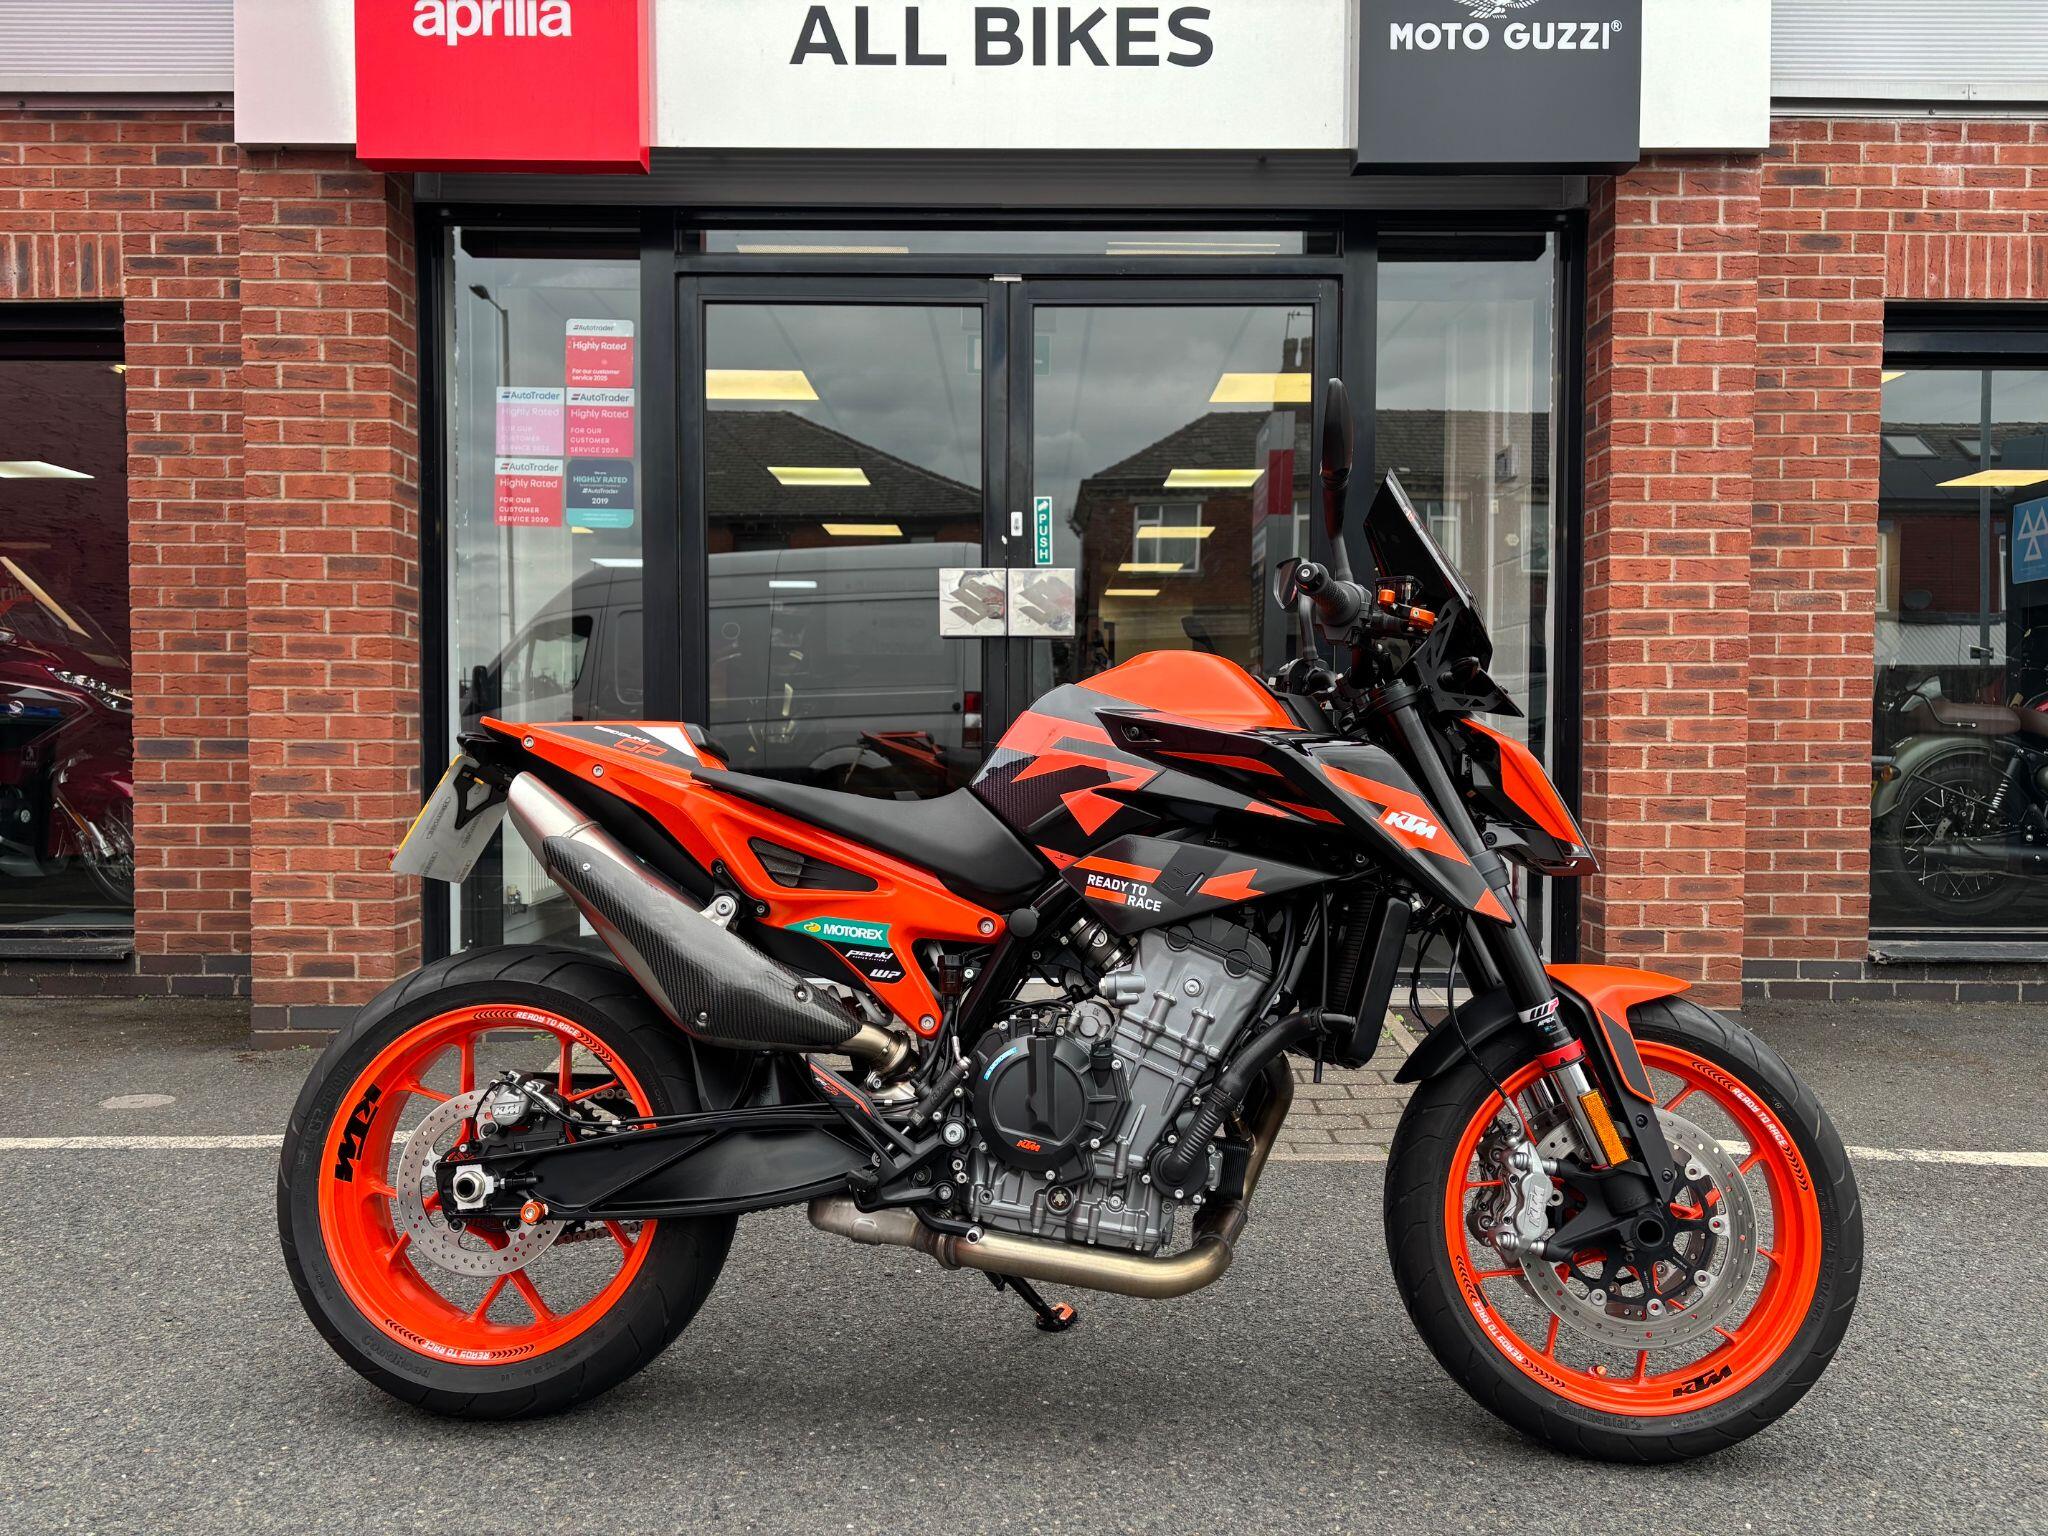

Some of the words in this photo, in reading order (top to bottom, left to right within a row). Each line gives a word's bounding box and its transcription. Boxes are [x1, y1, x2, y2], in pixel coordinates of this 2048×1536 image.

[789, 5, 947, 66] ALL
[974, 6, 1214, 67] BIKES
[1390, 23, 1489, 50] MOTO
[573, 340, 600, 351] Highly
[601, 341, 627, 350] Rated
[510, 391, 561, 400] AutoTrader
[580, 393, 630, 402] AutoTrader
[531, 407, 559, 416] Rated
[571, 409, 599, 419] Highly
[600, 410, 629, 418] Rated
[509, 463, 559, 472] AutoTrader
[500, 478, 529, 489] Highly
[530, 479, 558, 488] Rated
[1039, 514, 1049, 559] PUSH
[1384, 811, 1438, 839] KTM
[1087, 874, 1129, 892] READY
[1131, 883, 1148, 896] TO
[1127, 895, 1162, 912] RACE
[823, 923, 883, 940] MOTOREX
[516, 1011, 545, 1022] READY
[546, 1017, 557, 1027] TO
[557, 1021, 581, 1036] RACE
[494, 1104, 520, 1116] KTM
[1731, 1087, 1761, 1113] READY
[1759, 1112, 1772, 1125] TO
[1766, 1123, 1789, 1147] RACE
[335, 1083, 383, 1183] KTM
[1016, 1139, 1041, 1152] KTM
[1472, 1300, 1492, 1325] RACE
[1487, 1324, 1498, 1337] TO
[421, 1340, 447, 1355] RACE
[447, 1348, 459, 1358] TO
[459, 1350, 491, 1360] READY
[1496, 1335, 1525, 1361] READY
[1672, 1364, 1733, 1398] KTM
